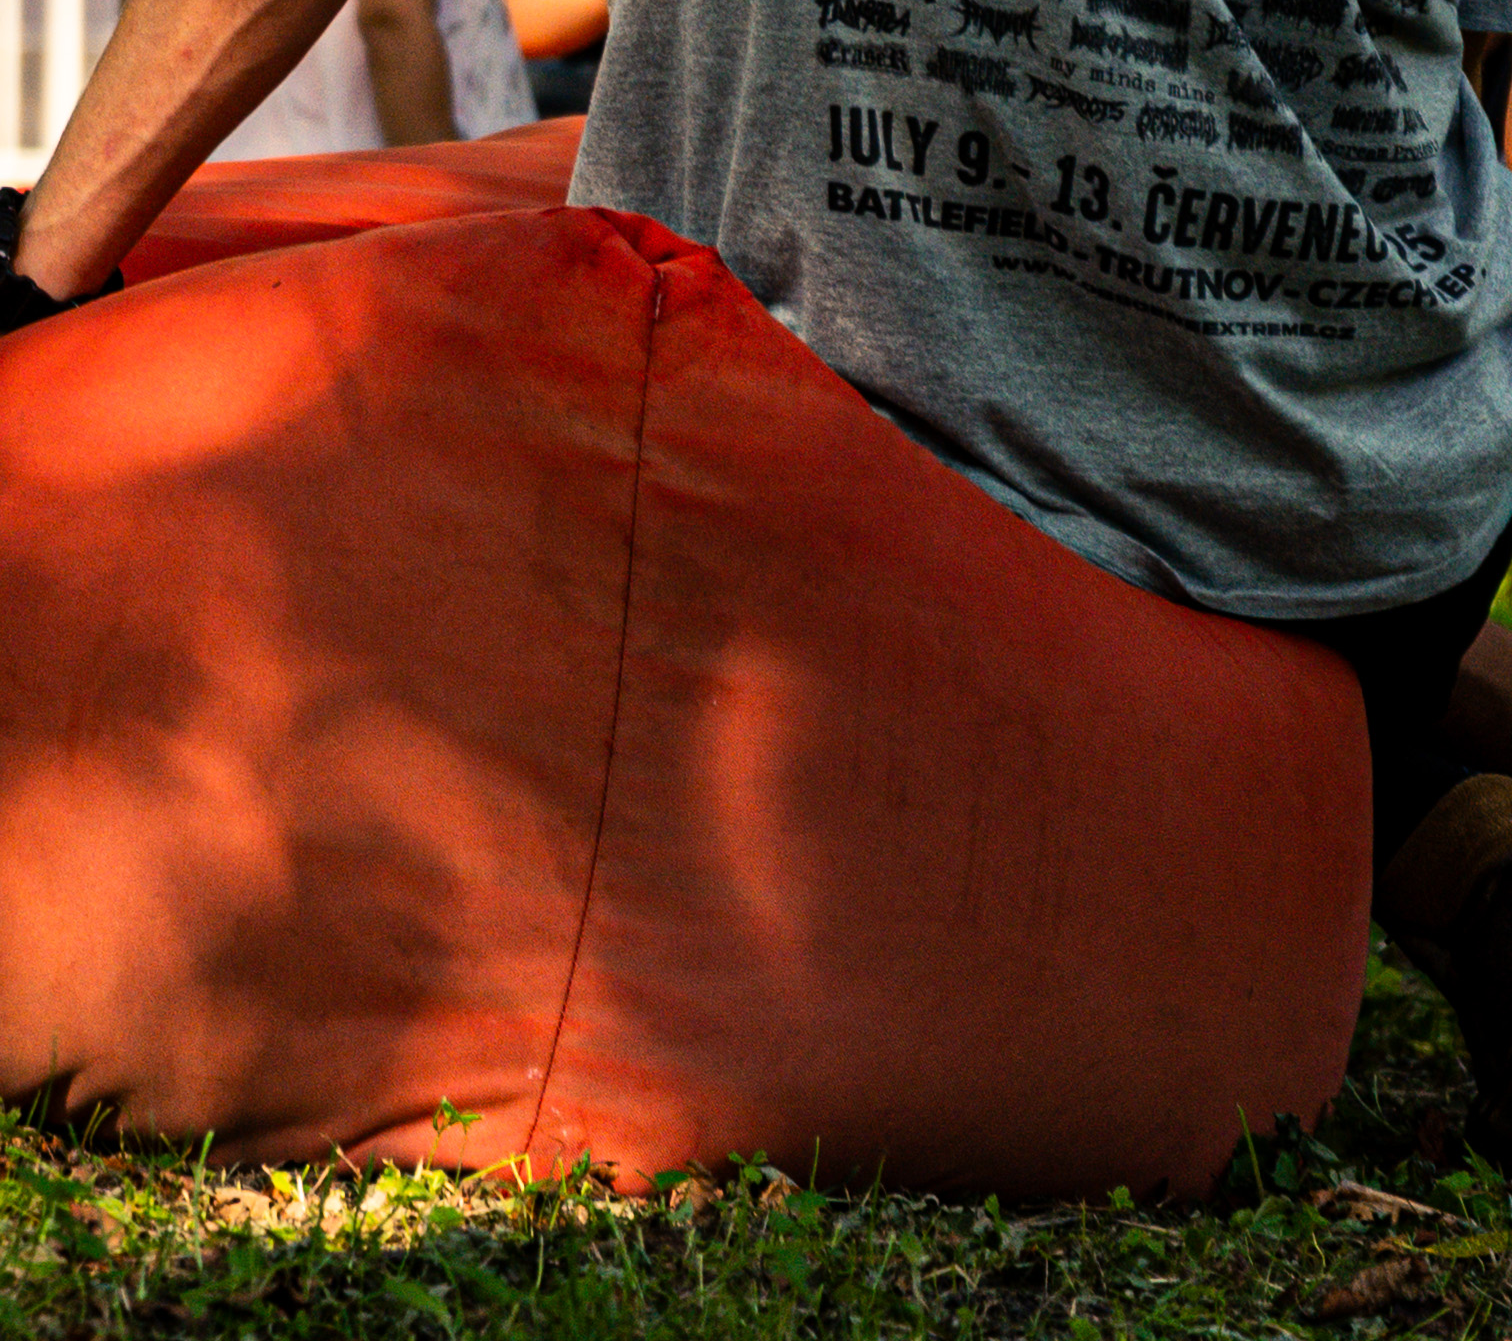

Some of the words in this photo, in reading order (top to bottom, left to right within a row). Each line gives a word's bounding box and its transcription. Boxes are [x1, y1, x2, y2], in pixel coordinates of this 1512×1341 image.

[1050, 56, 1076, 79] my
[1089, 67, 1157, 94] minds
[1168, 81, 1216, 105] mine
[829, 104, 940, 176] JULY
[1050, 154, 1123, 232] 13.
